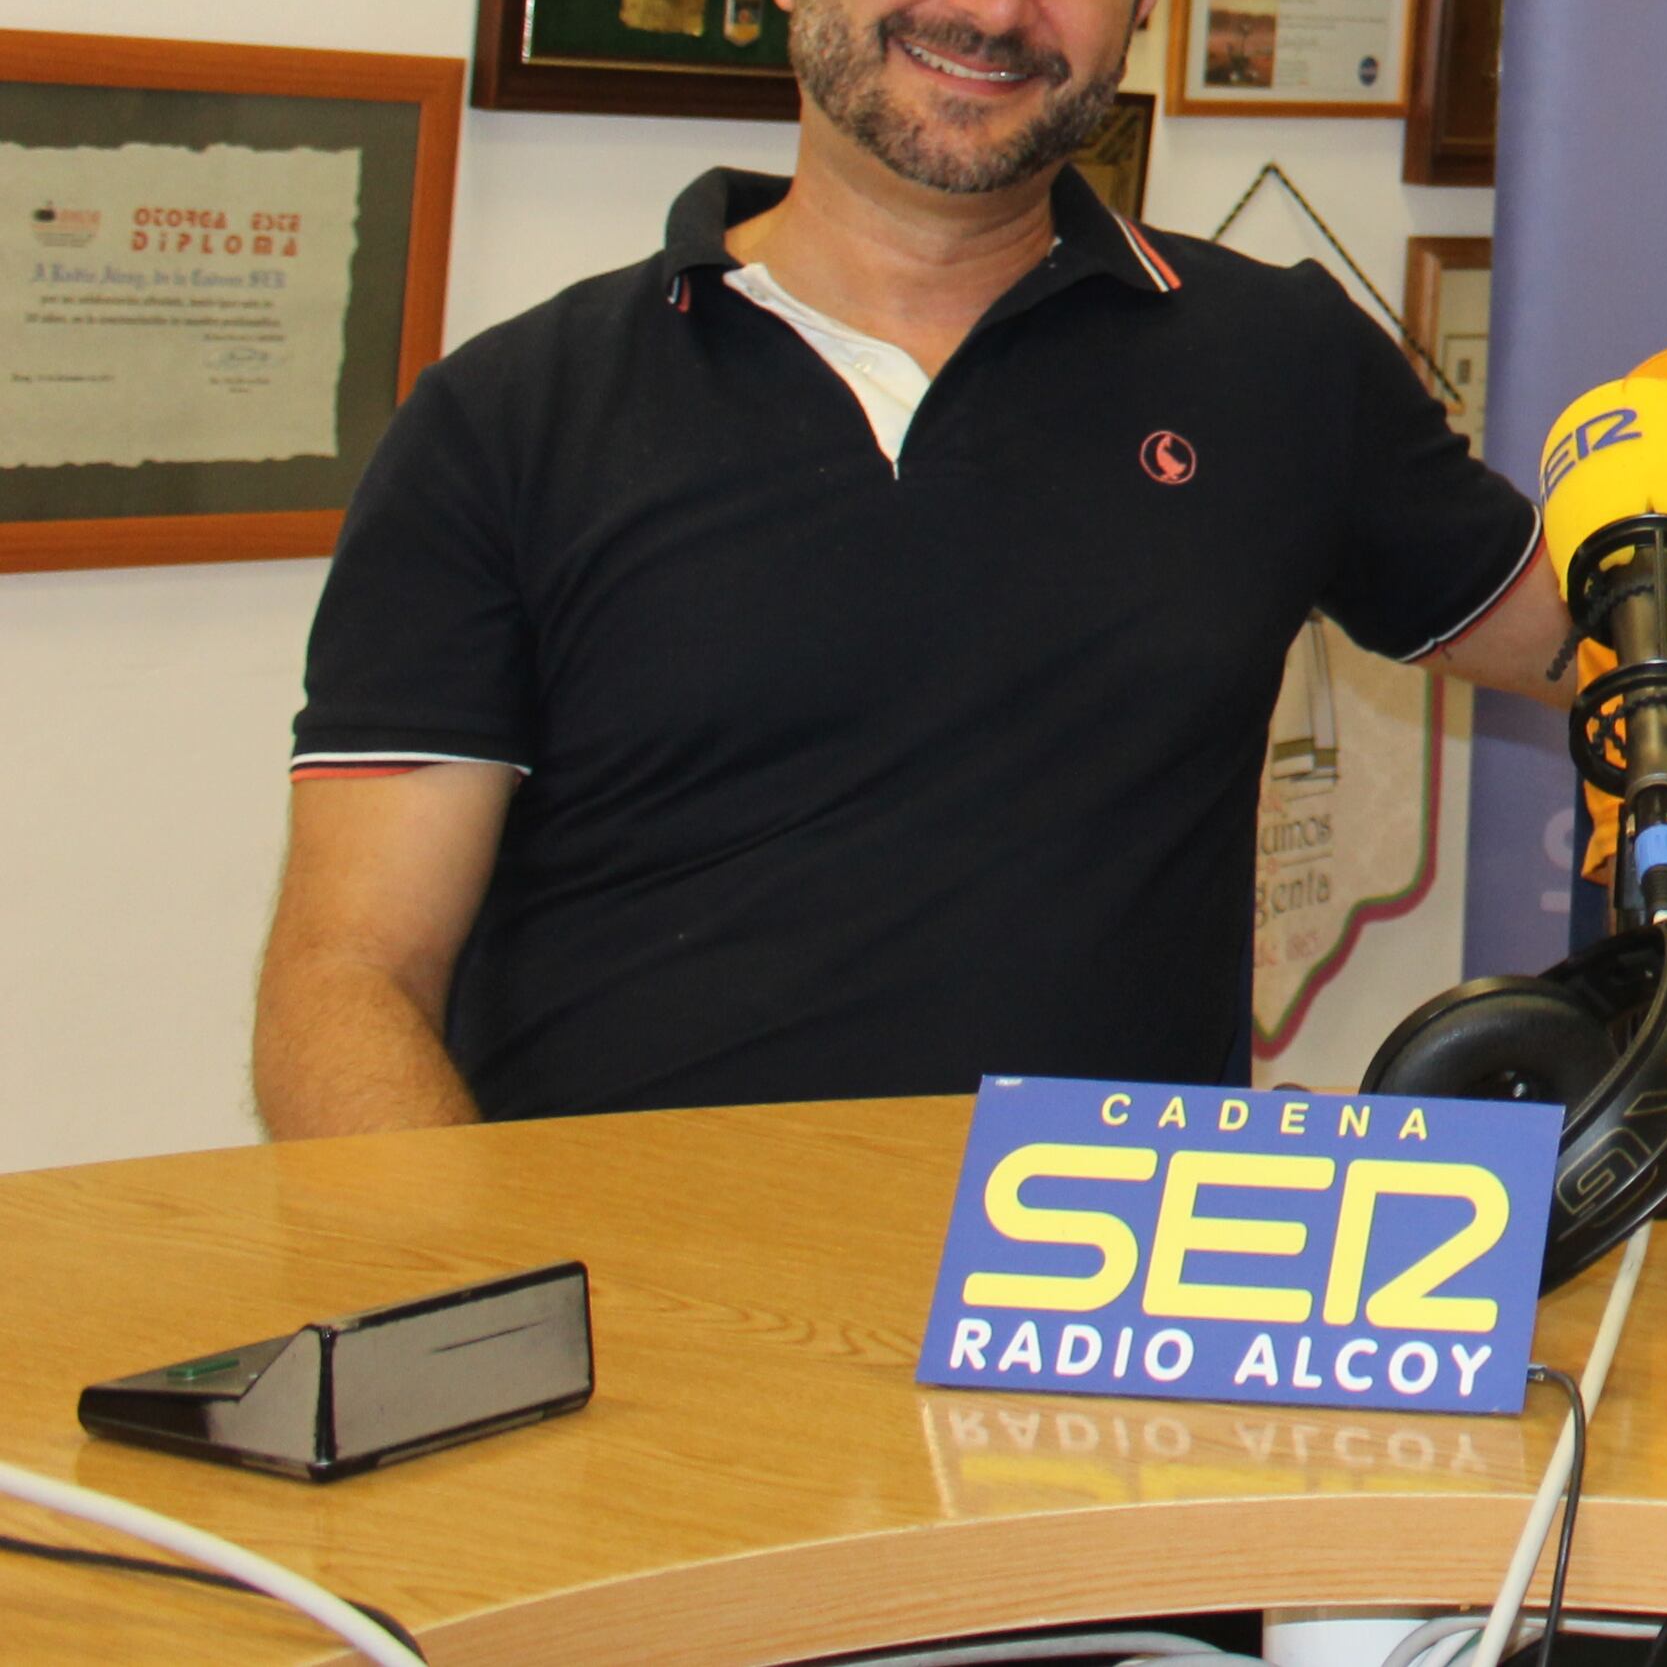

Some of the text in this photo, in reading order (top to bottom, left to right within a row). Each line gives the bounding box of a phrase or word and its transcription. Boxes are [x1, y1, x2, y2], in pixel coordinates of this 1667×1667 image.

[1541, 408, 1643, 504] ER
[1101, 1092, 1429, 1141] CADENA
[962, 1142, 1511, 1333] SER
[949, 1317, 1493, 1398] RADIO ALCOY
